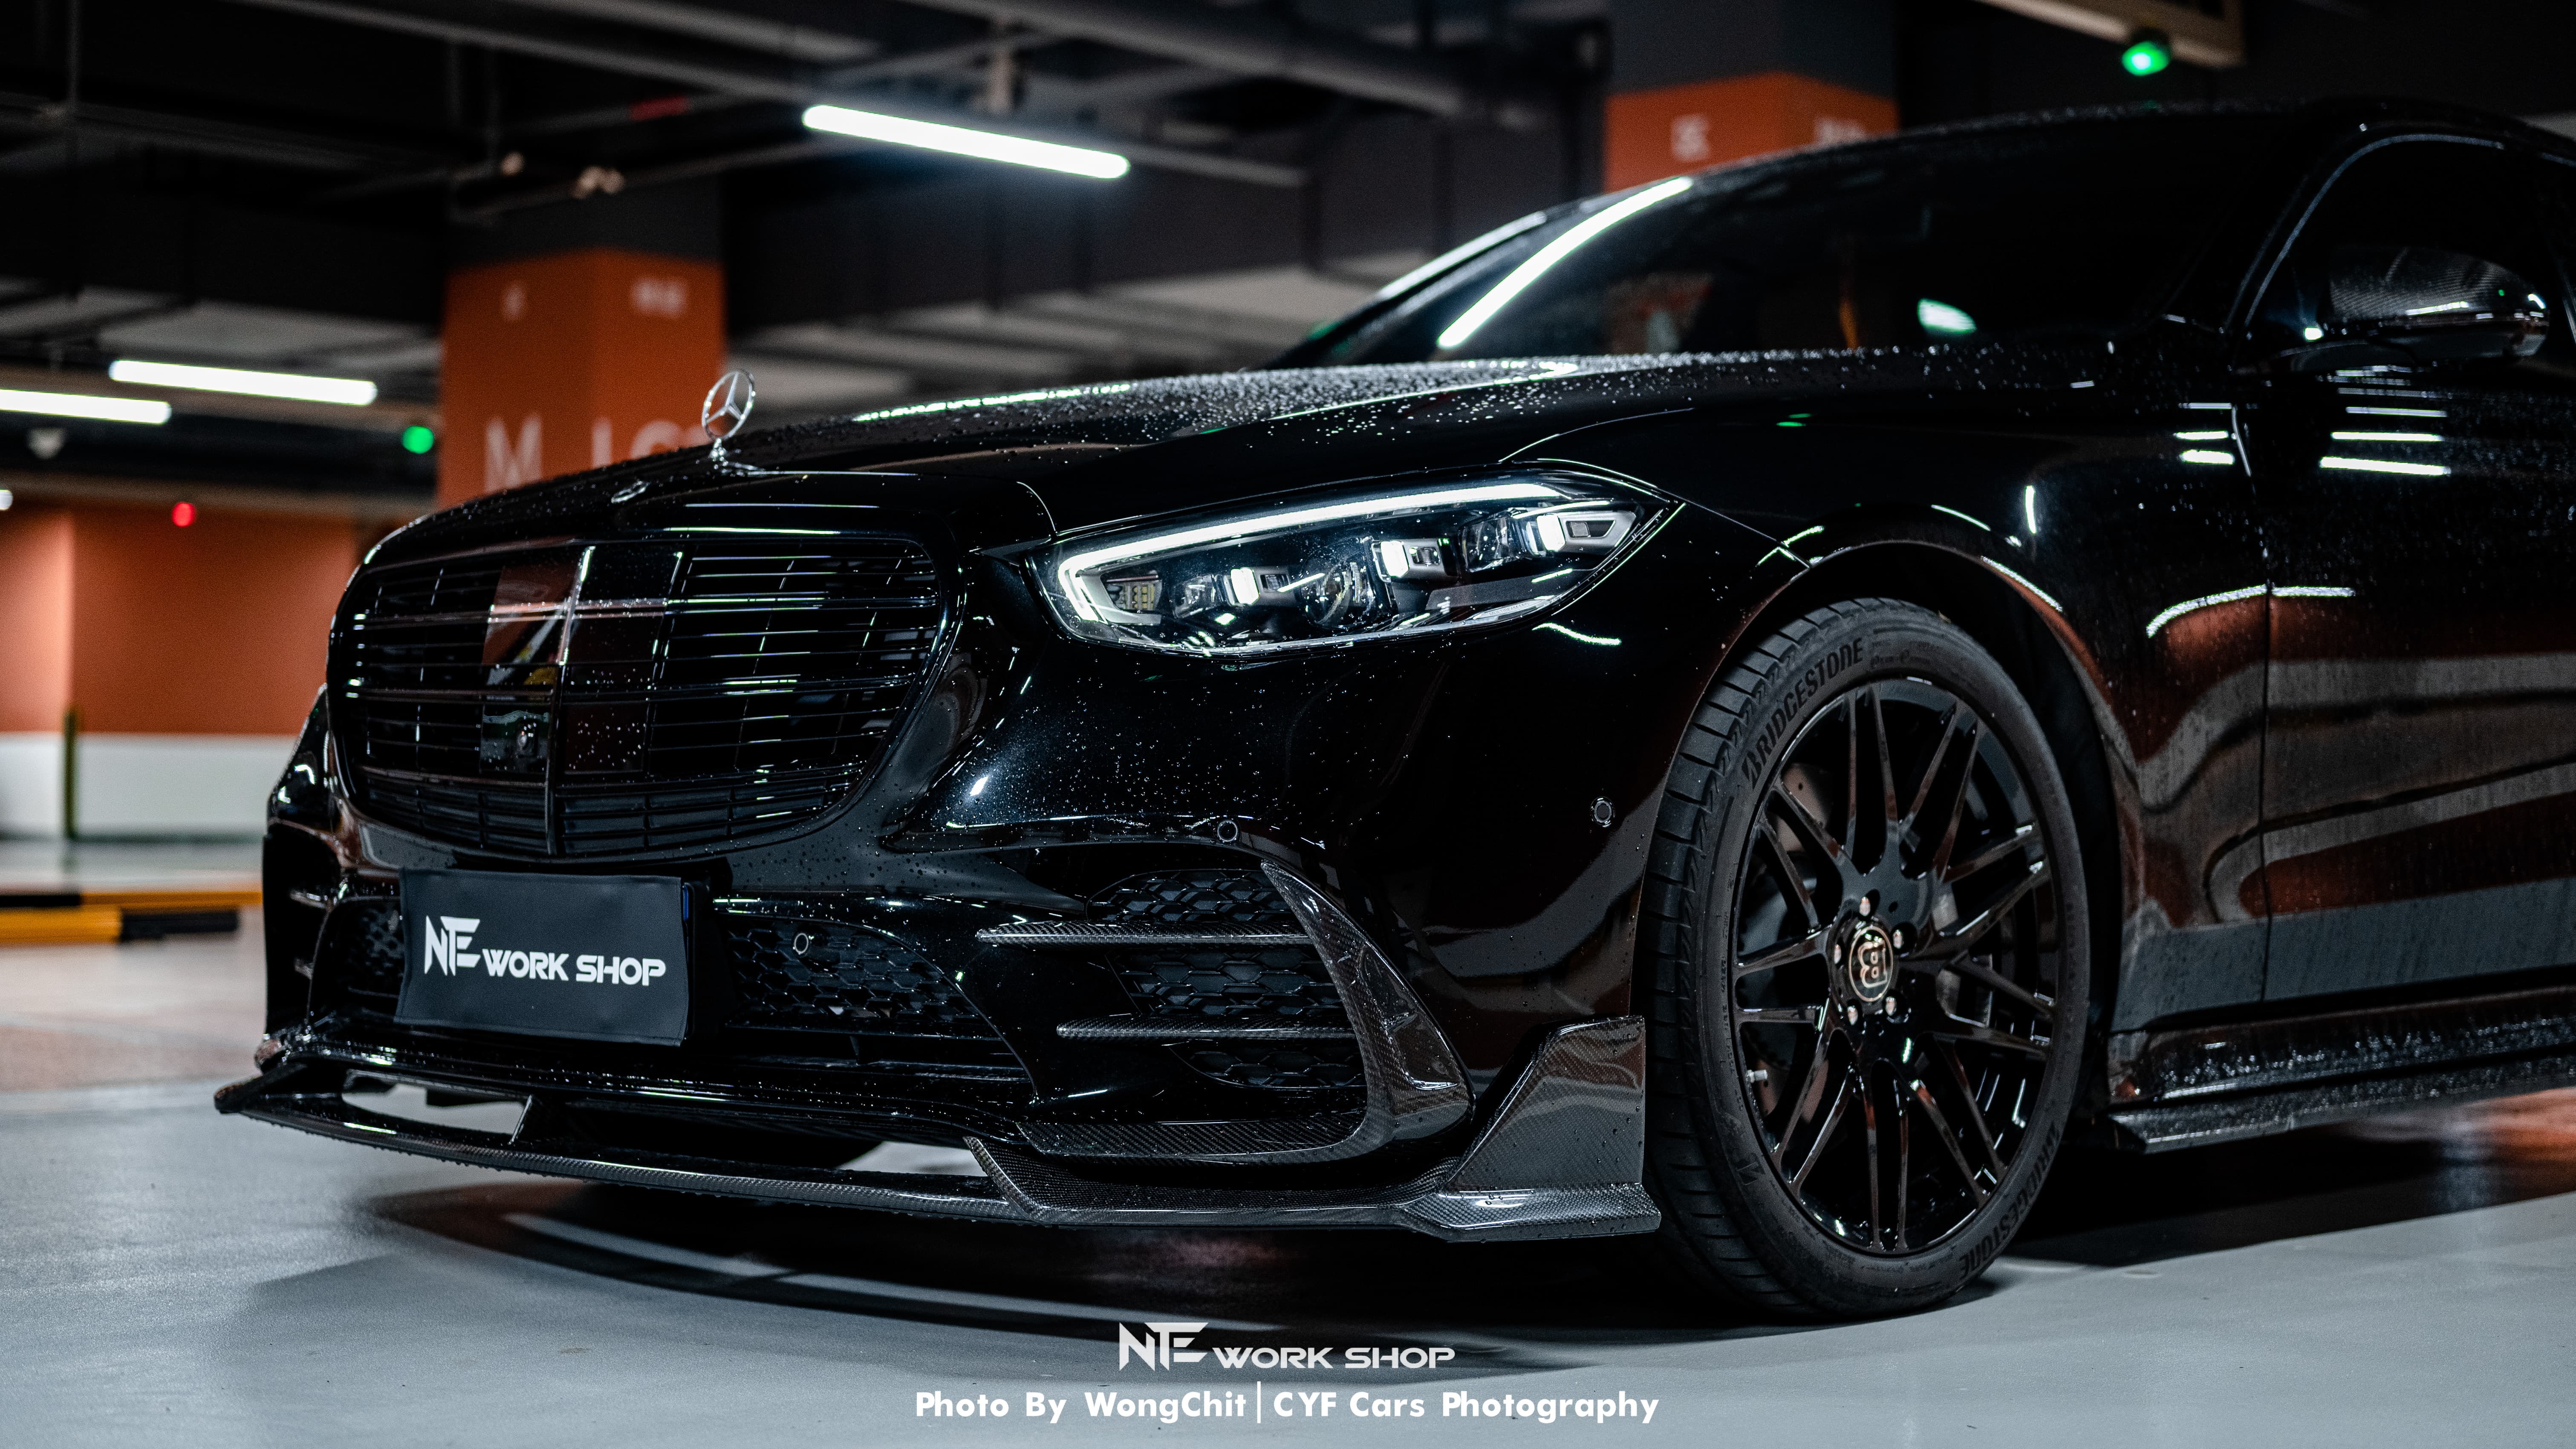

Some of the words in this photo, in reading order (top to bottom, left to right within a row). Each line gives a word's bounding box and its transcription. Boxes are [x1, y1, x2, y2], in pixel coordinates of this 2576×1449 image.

[1741, 638, 1864, 791] BRIDGESTONE
[482, 948, 569, 981] WORK
[576, 954, 667, 986] SHOP
